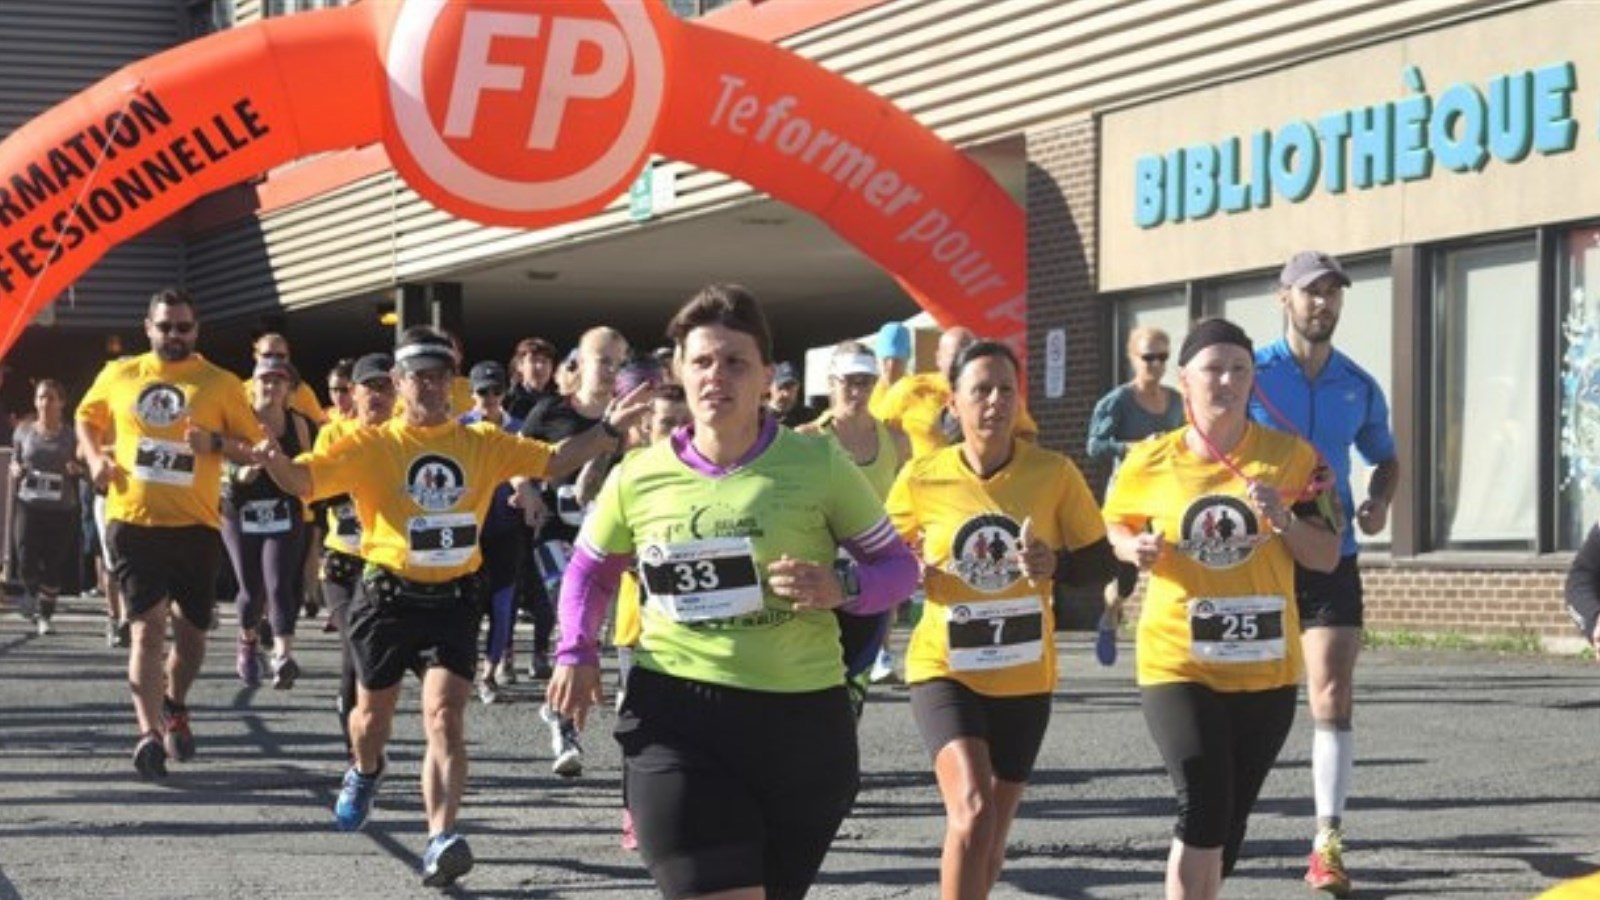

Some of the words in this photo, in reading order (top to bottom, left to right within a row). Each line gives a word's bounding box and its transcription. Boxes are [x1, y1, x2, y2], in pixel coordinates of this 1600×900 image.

[441, 9, 631, 151] FP
[1133, 62, 1578, 230] BIBLIOTHÈQUE
[755, 95, 923, 215] former
[897, 207, 1005, 296] pour
[153, 451, 177, 470] 27
[440, 528, 454, 549] 8
[673, 560, 720, 592] 33
[988, 618, 1006, 644] 7
[1221, 614, 1259, 640] 25
